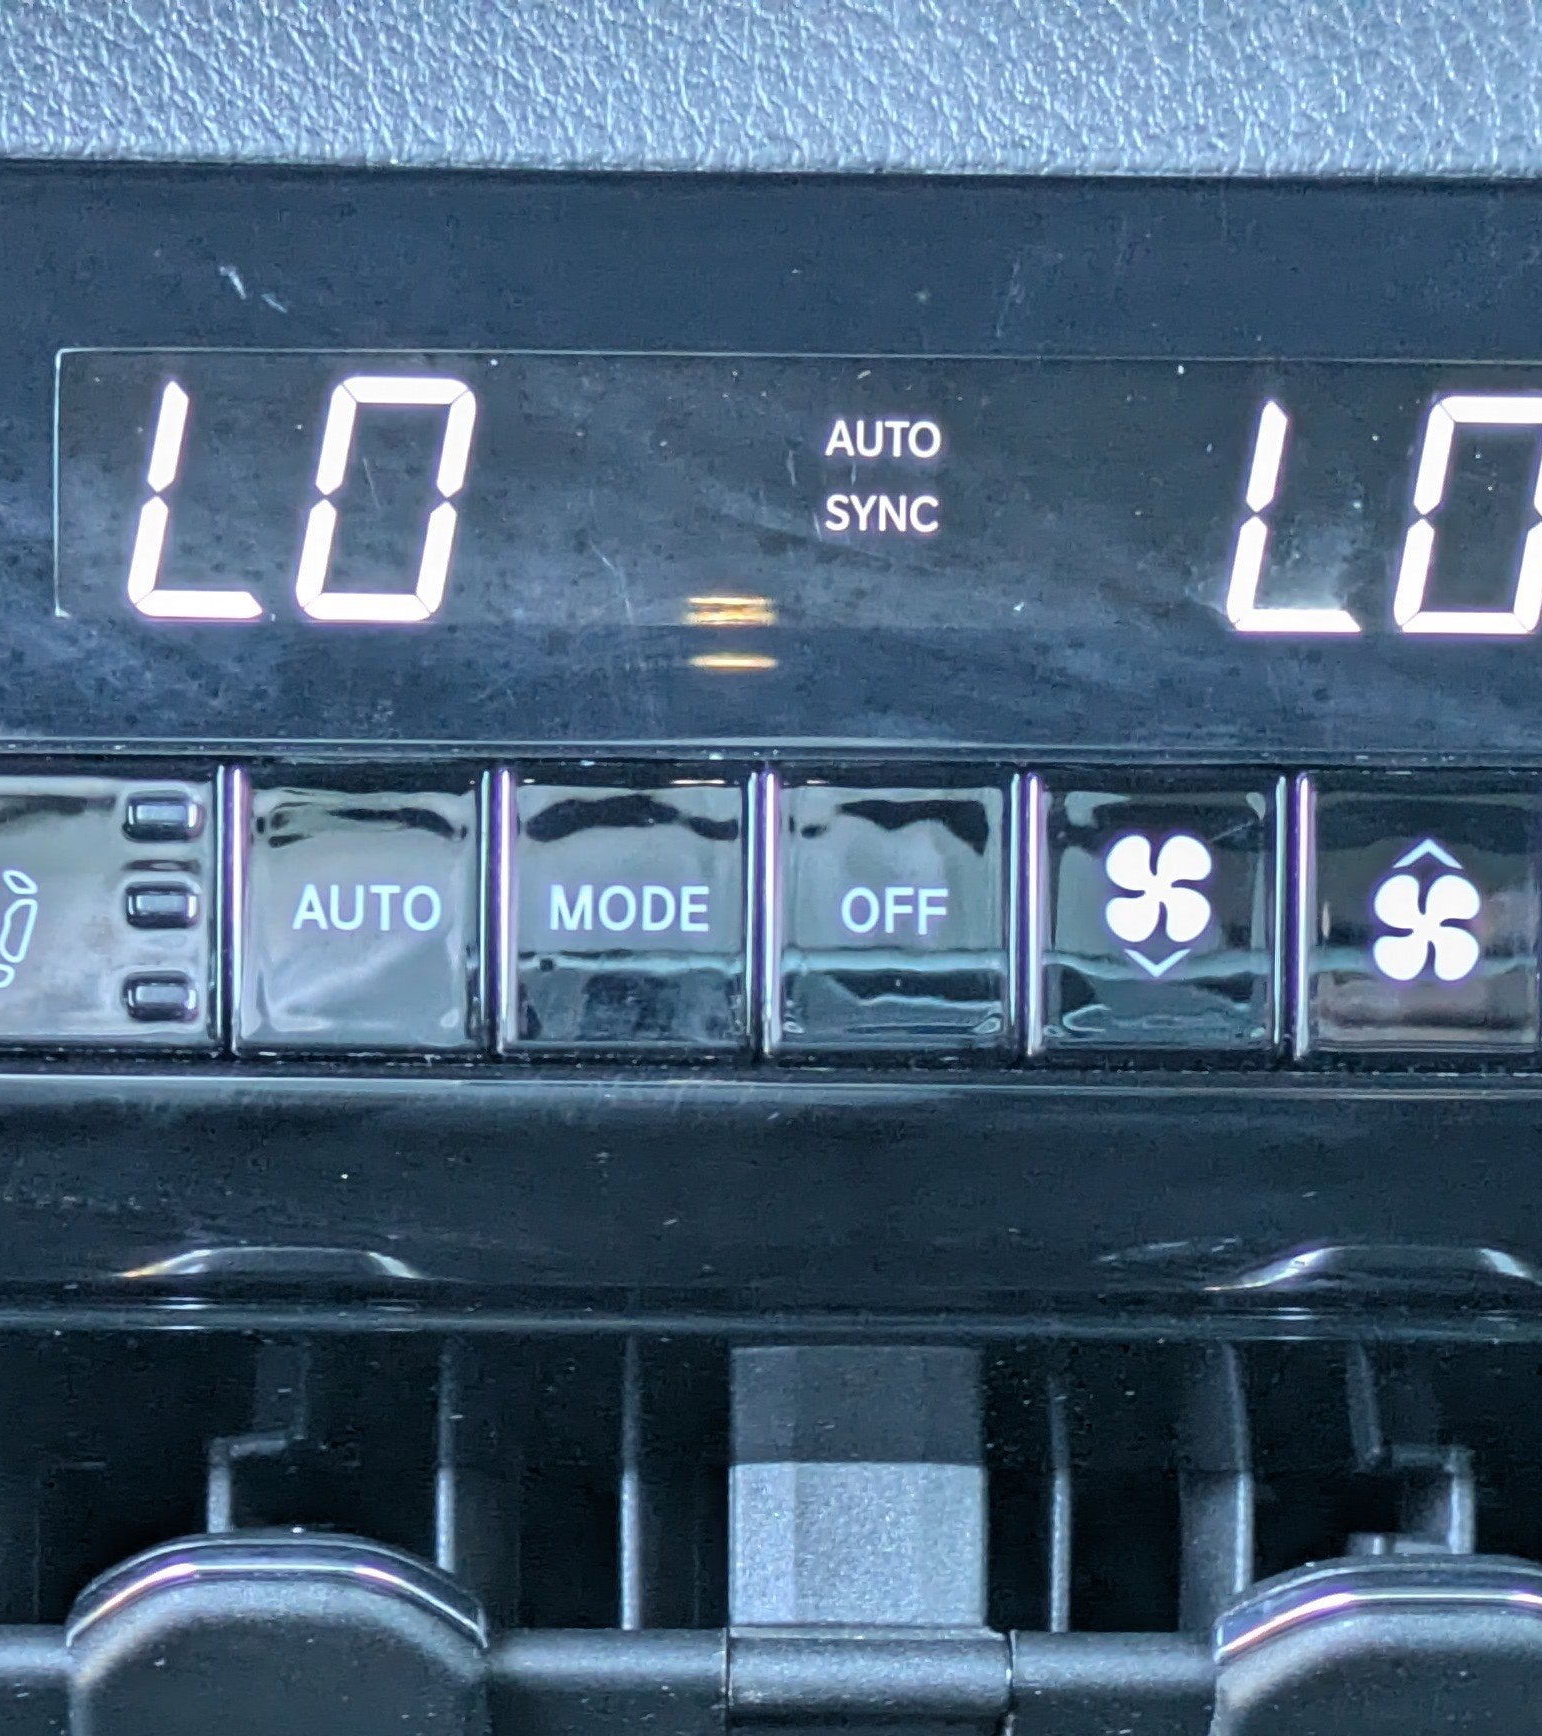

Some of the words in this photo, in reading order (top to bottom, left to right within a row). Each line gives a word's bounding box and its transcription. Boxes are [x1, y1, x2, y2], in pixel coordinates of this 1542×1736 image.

[823, 417, 943, 460] AUTO
[126, 375, 477, 622] LO
[822, 492, 941, 535] SYNC
[291, 883, 442, 933] AUTO
[549, 883, 711, 933] MODE
[840, 886, 950, 936] OFF
